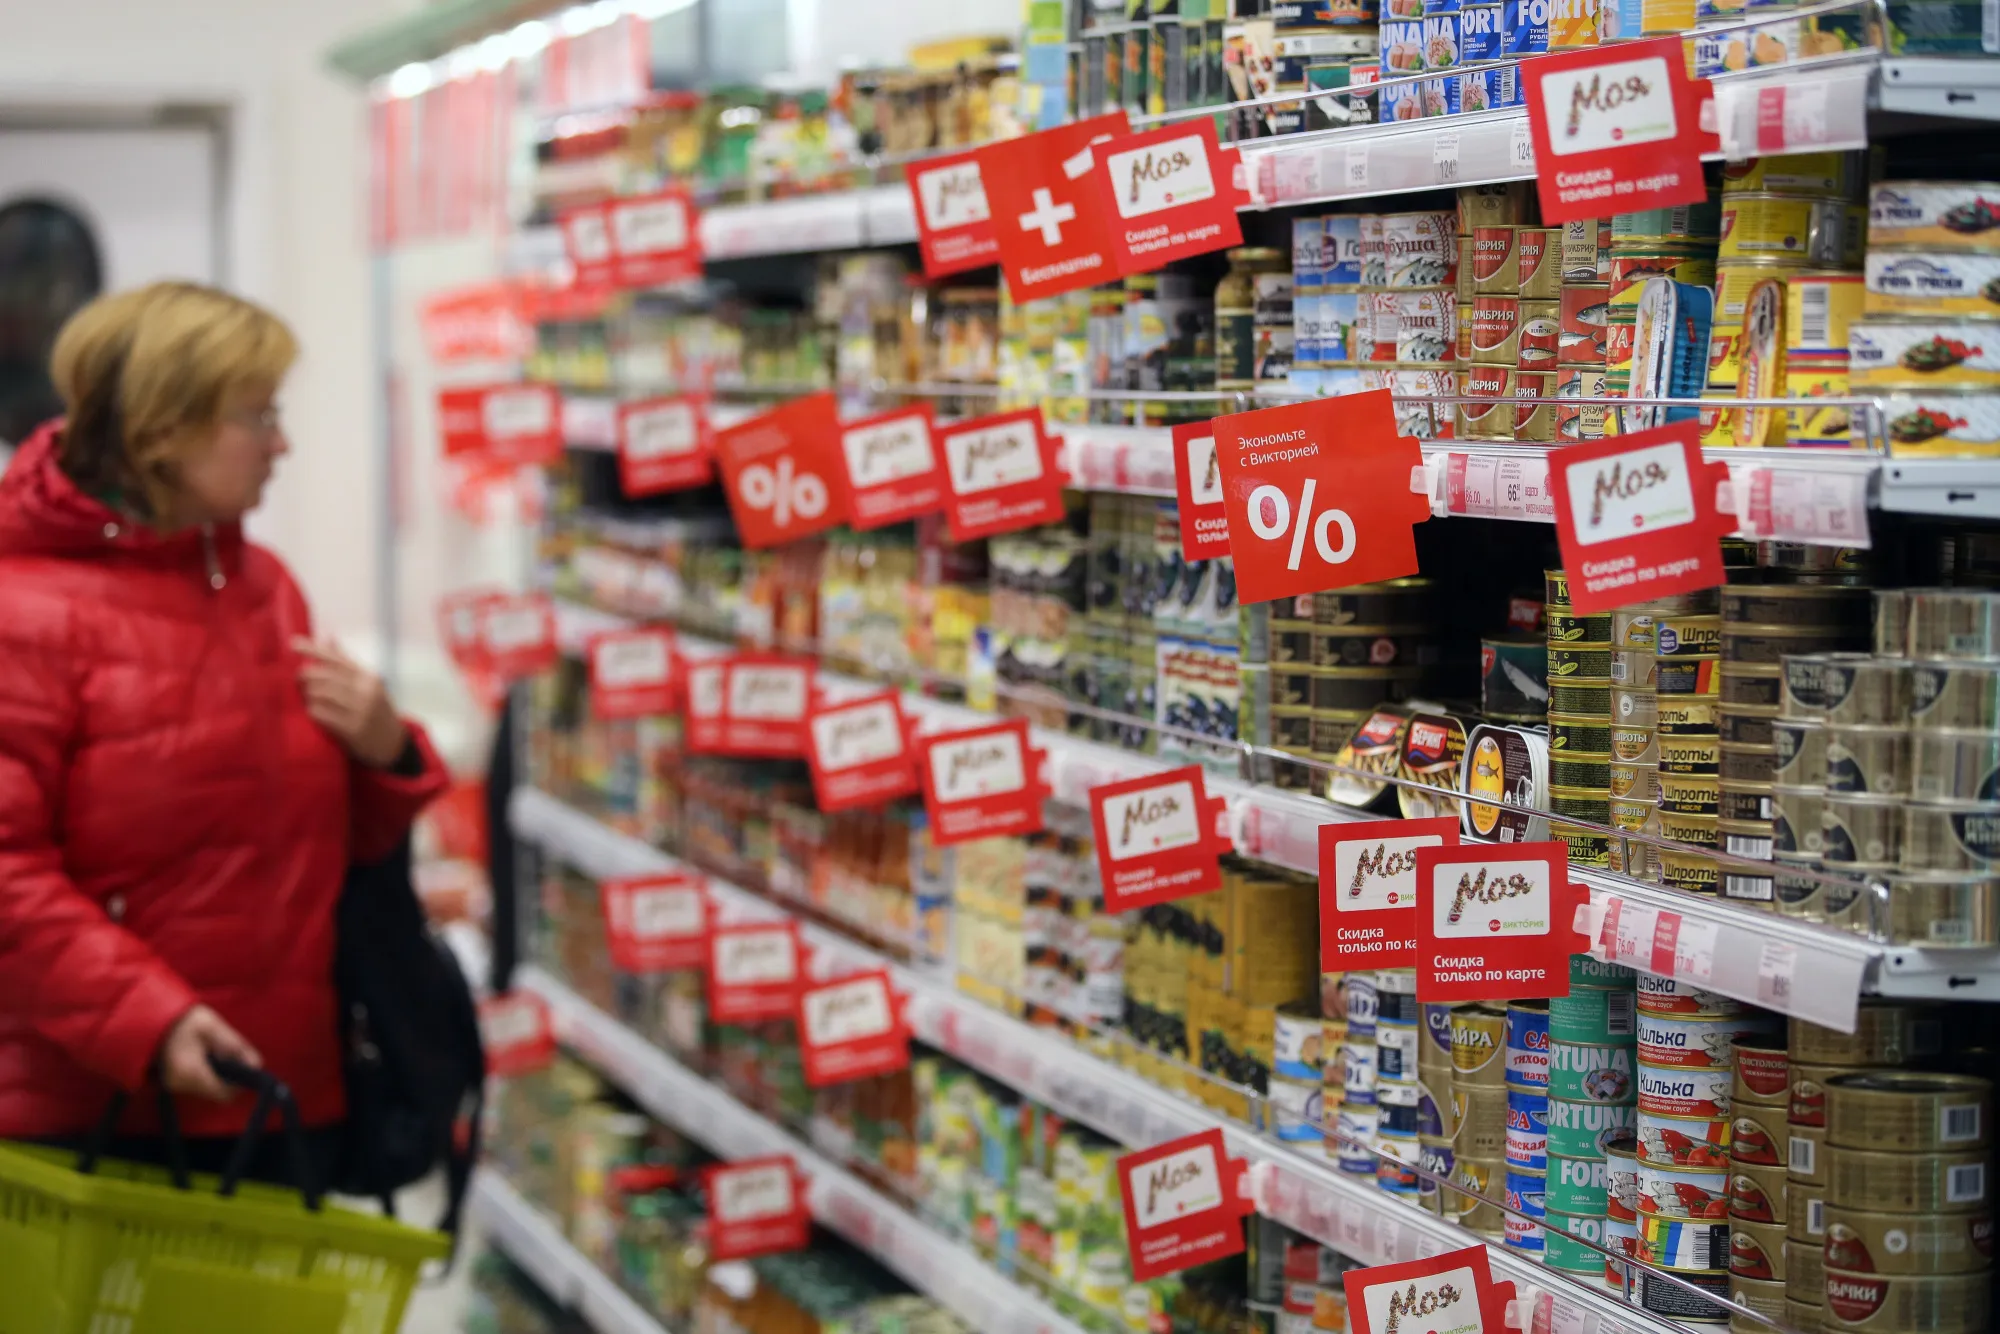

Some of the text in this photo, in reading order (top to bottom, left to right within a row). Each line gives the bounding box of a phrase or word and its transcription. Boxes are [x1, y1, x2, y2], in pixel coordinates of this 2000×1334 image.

[1555, 168, 1613, 188] Скидка
[1559, 173, 1680, 203] только по карте
[1020, 253, 1103, 286] Бесплатно
[1237, 429, 1306, 450] Экономьте
[1240, 443, 1319, 467] с Викторией
[1247, 478, 1356, 571] %
[1582, 556, 1635, 577] Скидка
[1658, 557, 1700, 577] карте
[1411, 726, 1445, 750] БЕРИНГ
[1660, 748, 1713, 763] Шпроты
[1446, 866, 1535, 926] Моя
[1337, 927, 1384, 941] Скидка
[1338, 941, 1383, 954] только
[1386, 942, 1400, 953] по
[1434, 955, 1484, 970] Скидка
[1434, 969, 1546, 983] только по карте
[1638, 1022, 1687, 1047] Килька
[1640, 1073, 1695, 1098] Килька
[1673, 1104, 1691, 1113] соусе
[1827, 1279, 1877, 1302] БЫЧКИ
